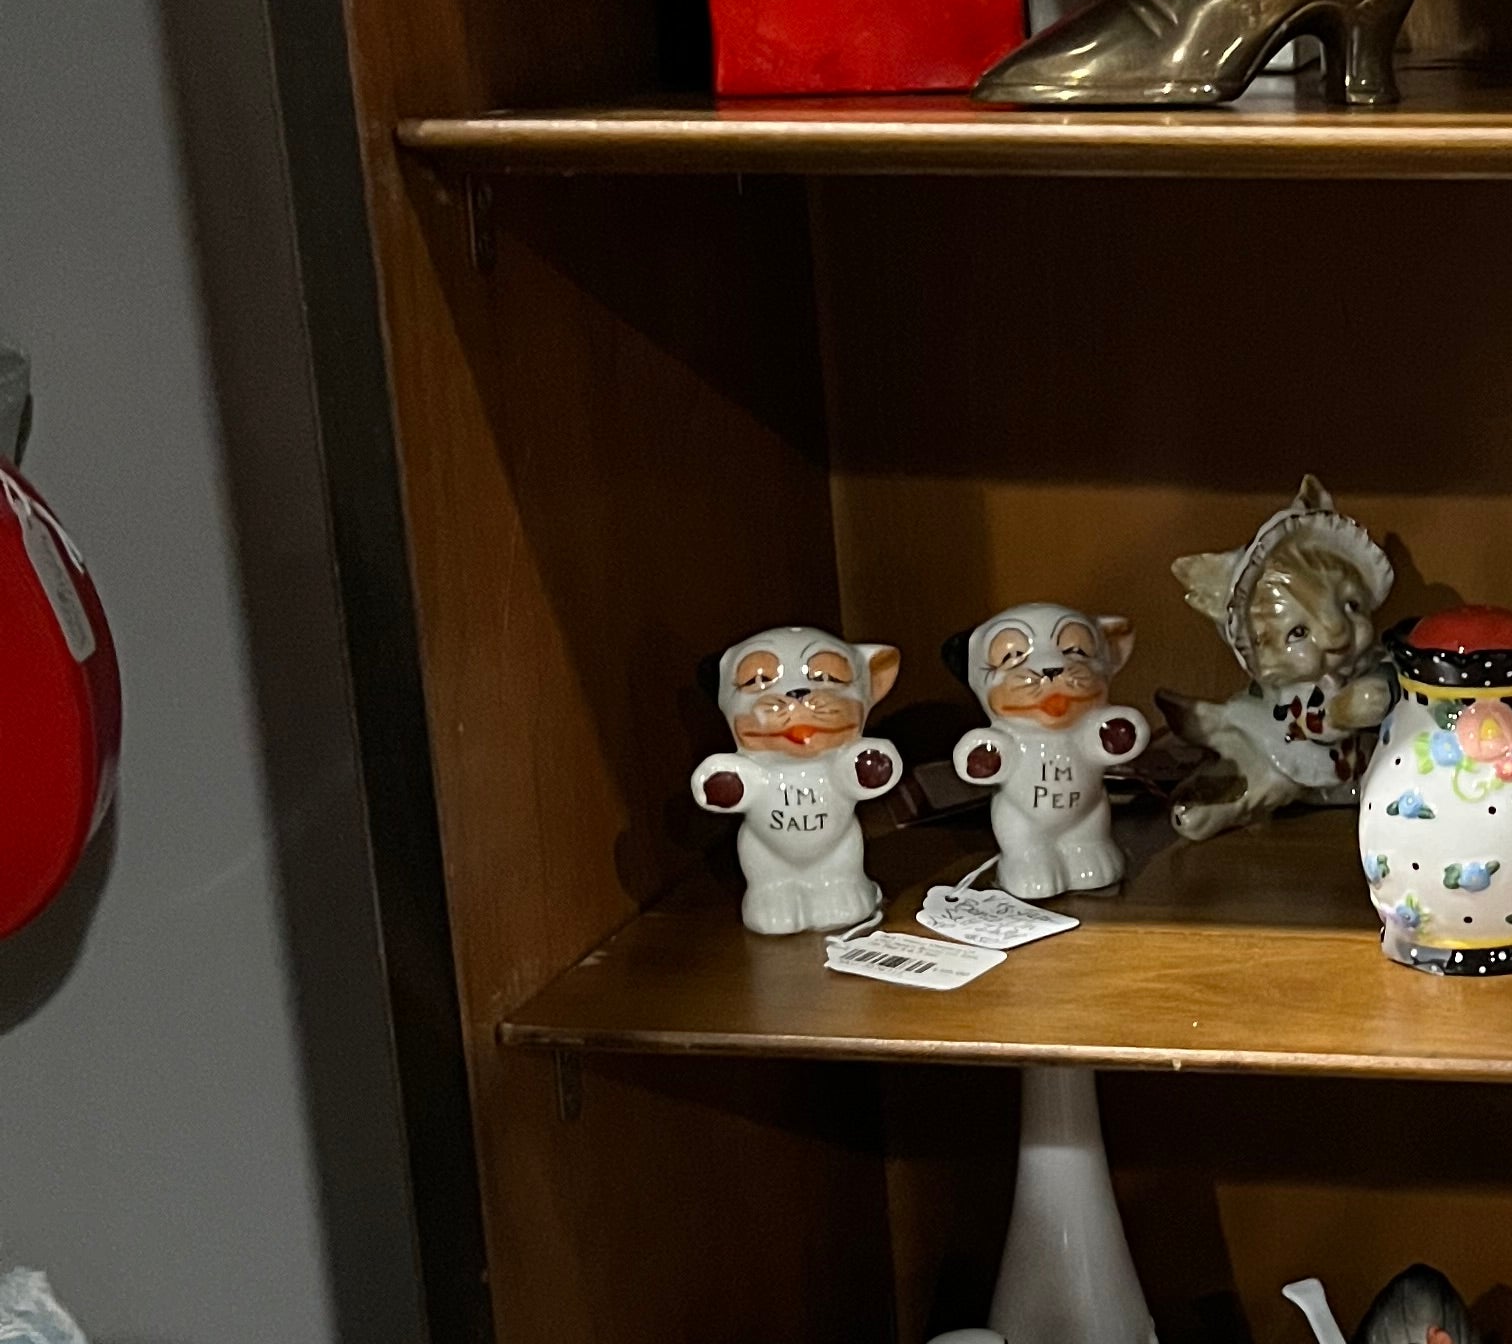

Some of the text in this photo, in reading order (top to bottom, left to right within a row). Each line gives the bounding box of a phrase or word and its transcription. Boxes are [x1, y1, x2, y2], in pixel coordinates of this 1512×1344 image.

[1041, 760, 1073, 782] I'M
[780, 784, 817, 806] I'M
[769, 809, 829, 832] SALT
